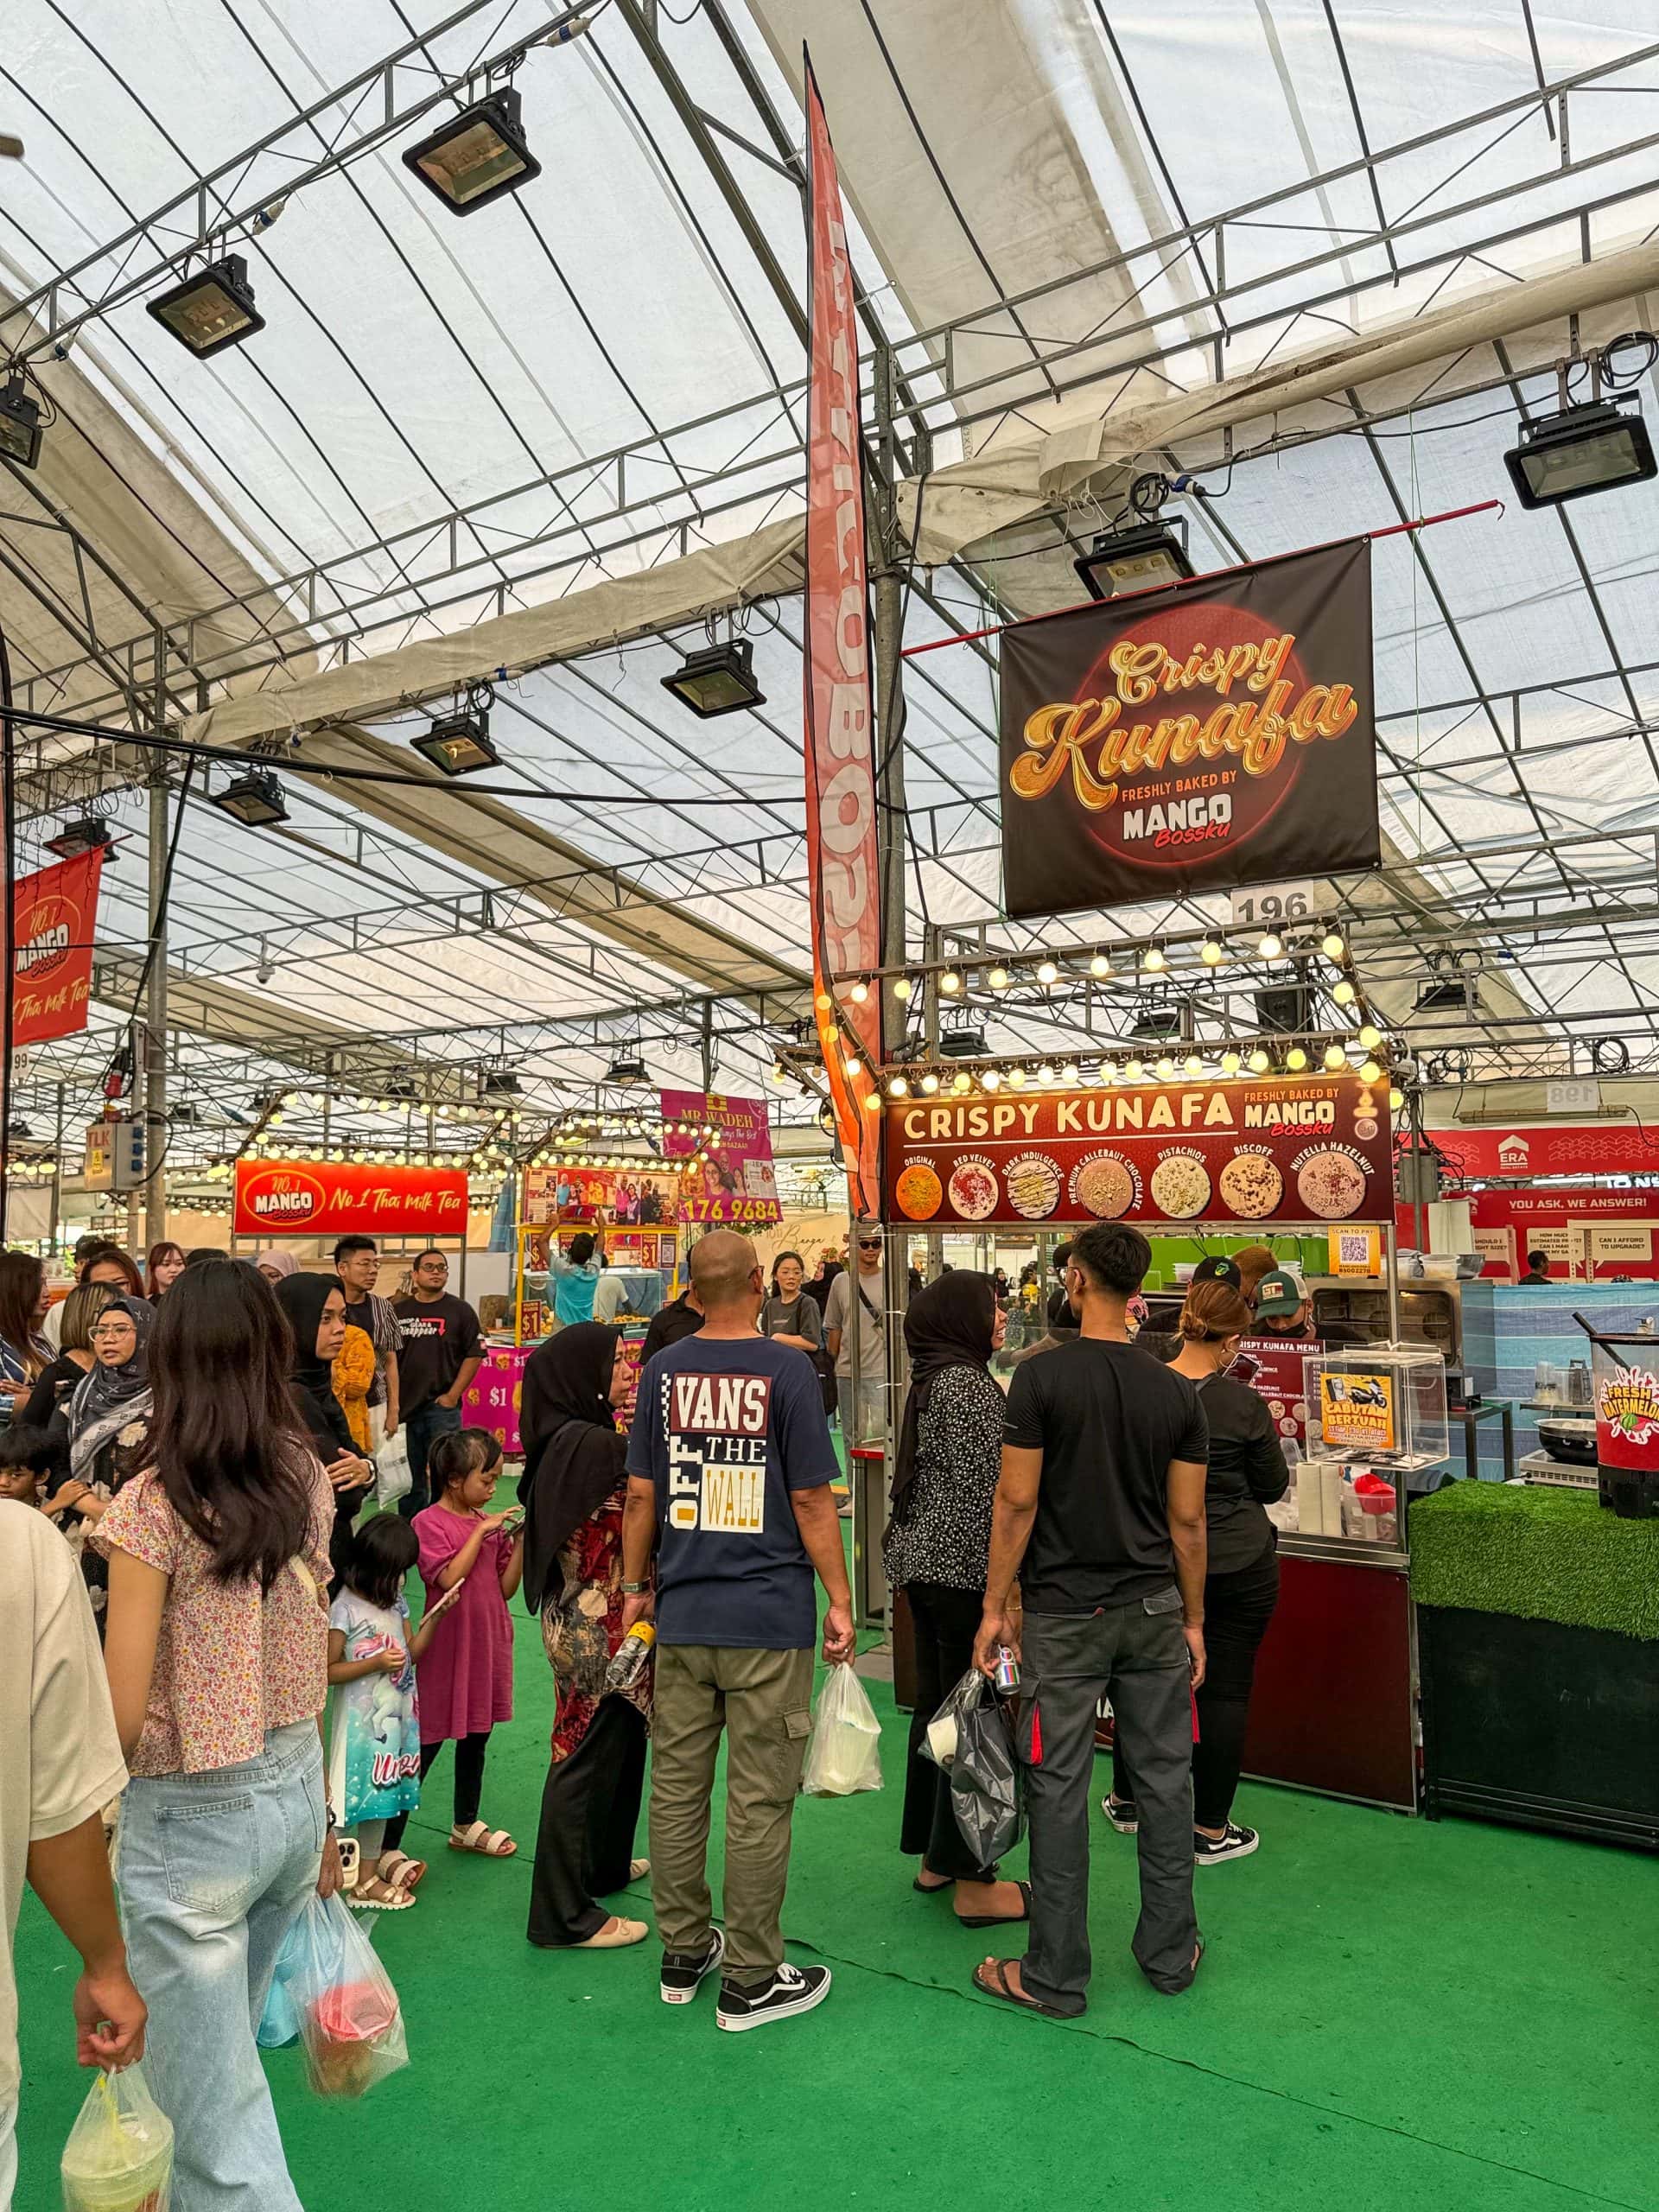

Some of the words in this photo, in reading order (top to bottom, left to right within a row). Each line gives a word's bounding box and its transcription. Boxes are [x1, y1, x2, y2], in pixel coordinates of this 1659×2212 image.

[1109, 634, 1296, 705] Crispy
[1009, 679, 1358, 814] Kunafa
[1122, 781, 1172, 803] FRESHLY
[1175, 775, 1219, 793] BAKED
[1221, 769, 1237, 785] BY
[1123, 792, 1232, 841] MANGO
[1238, 893, 1307, 922] 196
[16, 923, 69, 974] MANGO
[70, 976, 90, 1010] Tea
[1244, 1090, 1286, 1103] FRESHLY
[1289, 1088, 1324, 1101] BAKED
[1326, 1088, 1339, 1099] BY
[681, 1109, 702, 1122] MR
[706, 1111, 753, 1129] WADEH
[904, 1103, 1040, 1139] CRISPY
[1057, 1092, 1235, 1134] KUNAFA
[1244, 1101, 1336, 1128] MANGO
[904, 1154, 937, 1169] ORIGINAL
[953, 1154, 969, 1167] RED
[969, 1154, 996, 1171] VELVET
[1157, 1146, 1207, 1164] PISTACHIOS
[1233, 1144, 1274, 1157] BISCOFF
[1289, 1141, 1328, 1172] NUTELLA
[1329, 1141, 1376, 1176] HAZELNUT
[1499, 1152, 1528, 1164] ERA
[1001, 1154, 1020, 1177] DARK
[1020, 1151, 1065, 1180] INDULGENCE
[1068, 1164, 1082, 1205] PREMIUM
[1079, 1148, 1125, 1167] CALLEBAUT
[1123, 1159, 1144, 1211] CHOCOLATE
[256, 1192, 314, 1213] MANGO
[372, 1188, 400, 1213] Thai
[437, 1190, 462, 1214] Tea
[731, 1200, 779, 1220] 9684
[1510, 1201, 1534, 1210] YOU
[1567, 1198, 1586, 1208] WE
[1589, 1198, 1648, 1208] ANSWER!
[522, 1312, 539, 1333] $1
[1262, 1341, 1295, 1351] KUNAFA
[1296, 1344, 1320, 1352] MENU
[489, 1387, 507, 1408] $1
[676, 1376, 767, 1432] VANS
[1607, 1386, 1652, 1399] FRESH
[1325, 1403, 1389, 1419] CABUTAN
[1327, 1414, 1388, 1431] BERTUAH
[706, 1435, 767, 1464] THE
[669, 1435, 704, 1531] OFF
[706, 1469, 760, 1528] WALL
